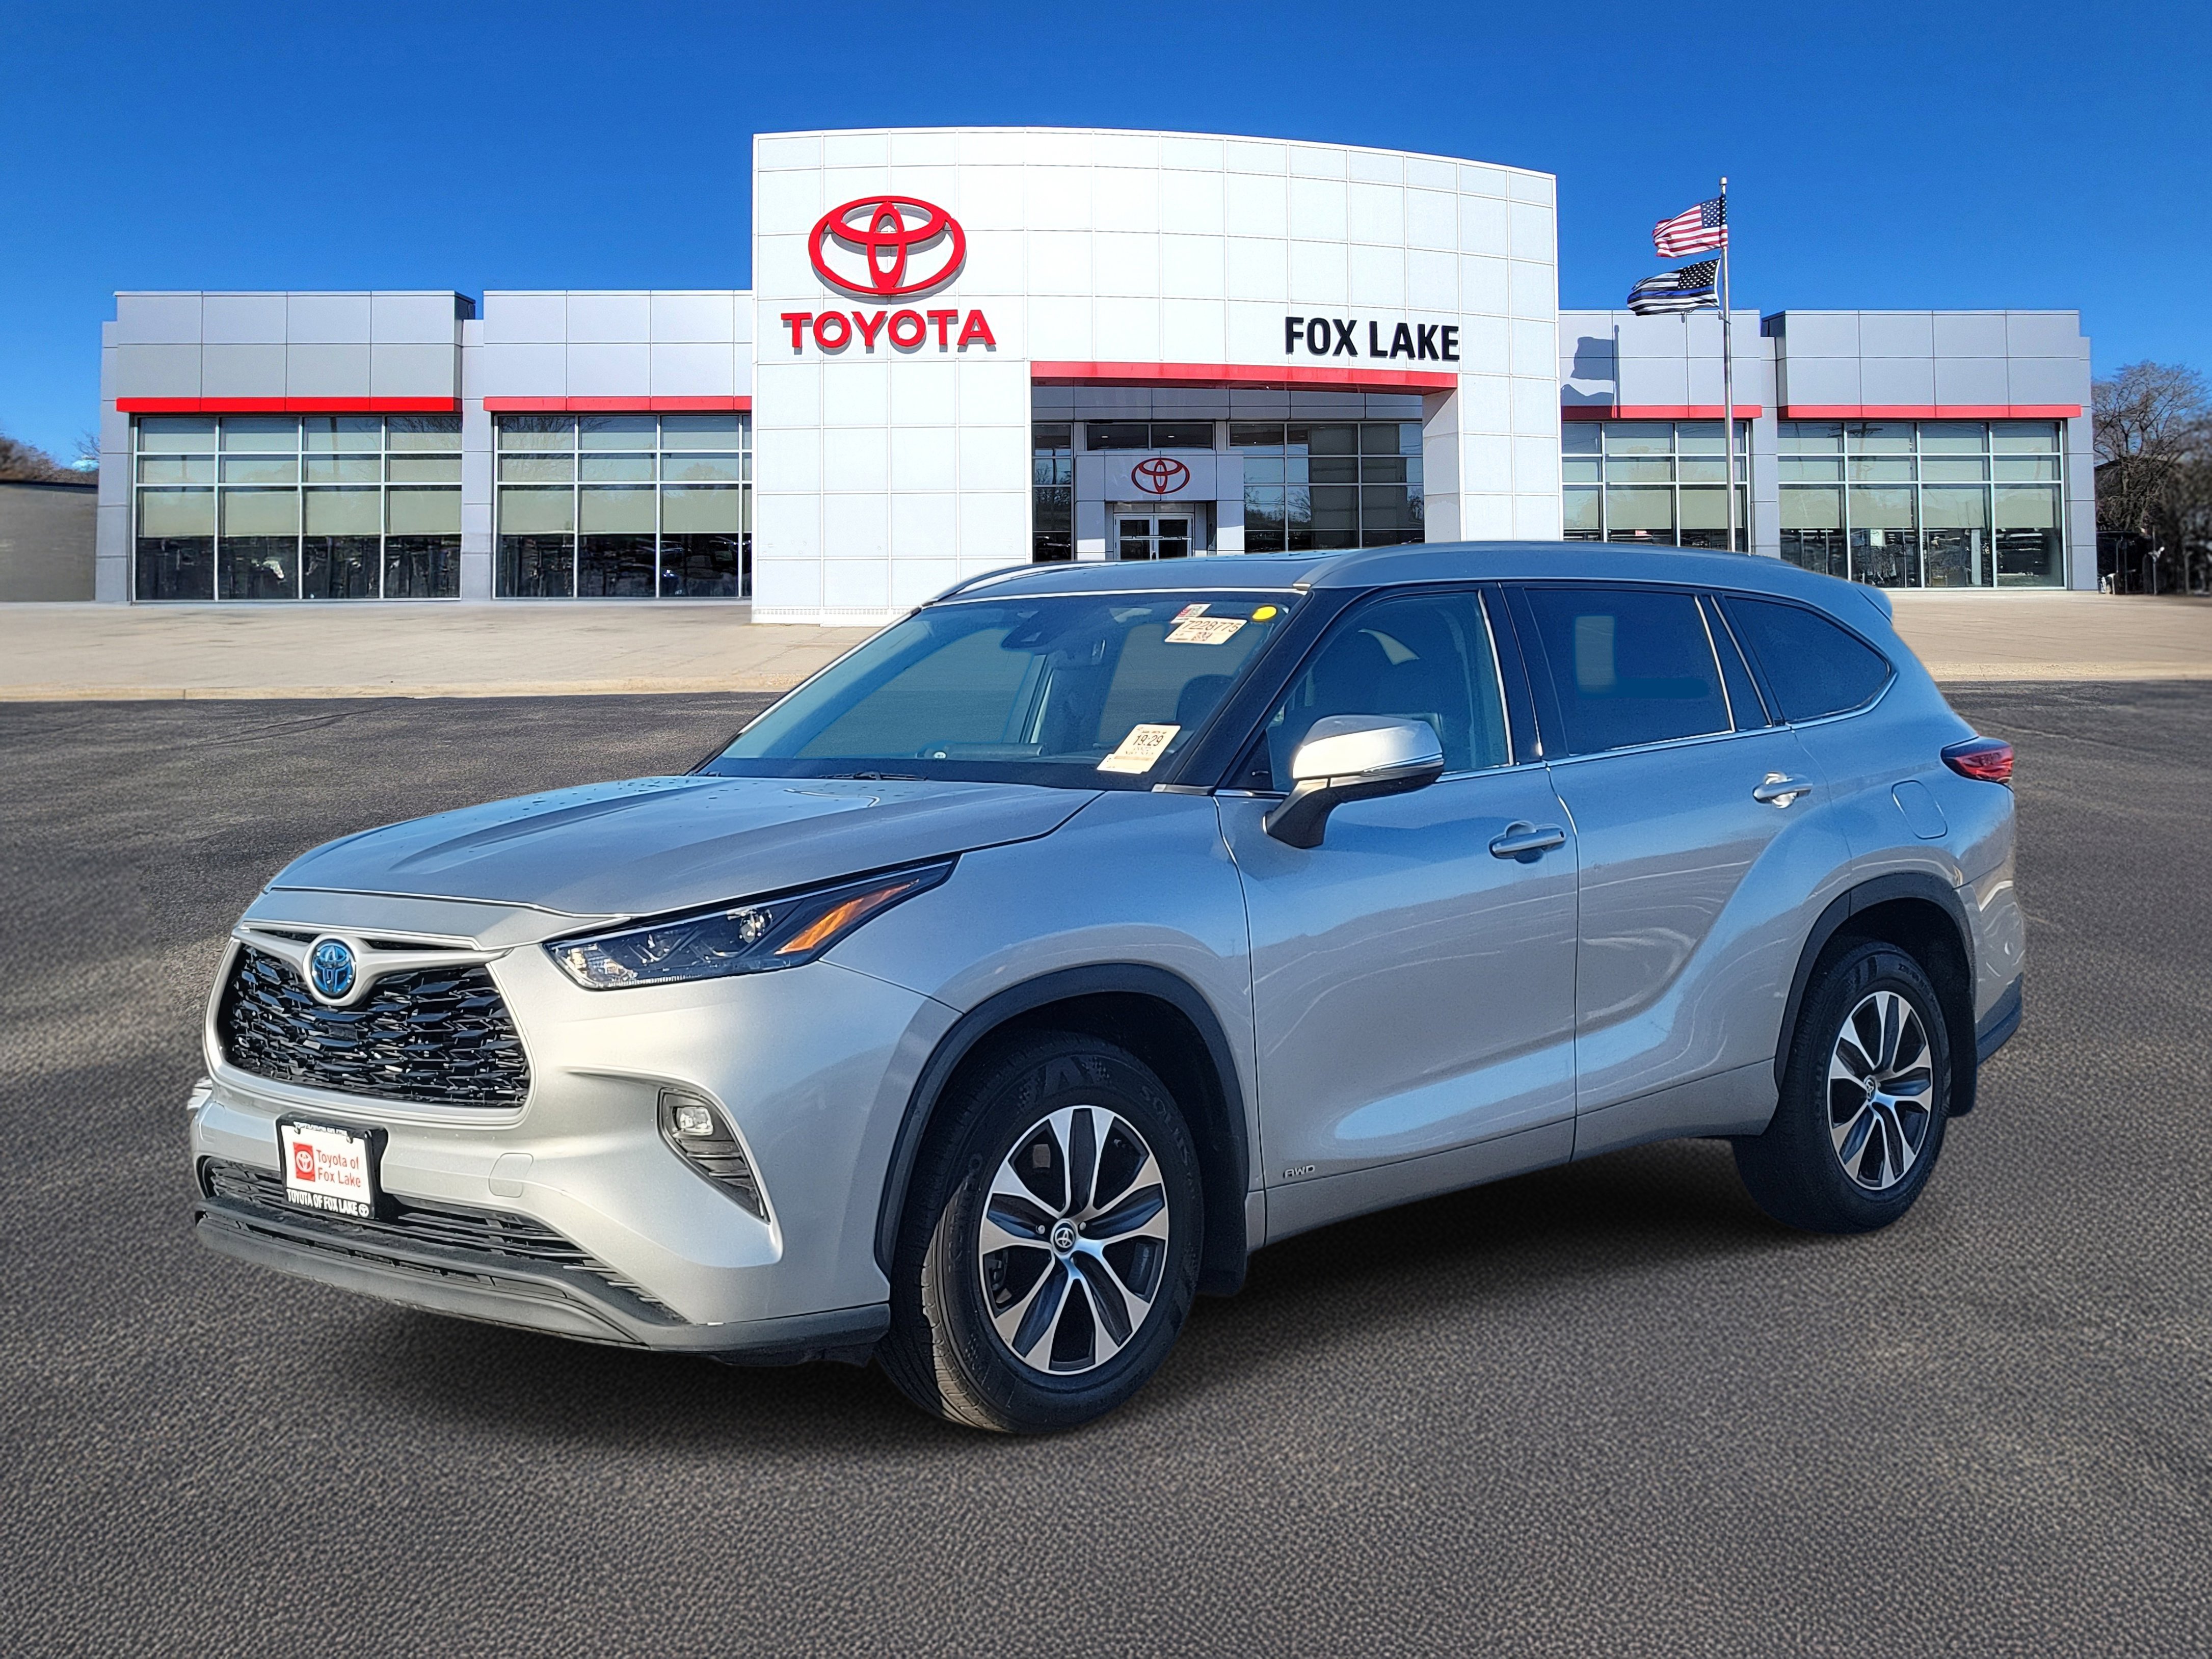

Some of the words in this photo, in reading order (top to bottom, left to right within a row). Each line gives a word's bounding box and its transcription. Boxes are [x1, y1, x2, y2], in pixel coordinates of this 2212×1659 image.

[781, 310, 996, 348] TOYOTA
[1285, 316, 1358, 356] FOX
[1369, 321, 1459, 360] LAKE
[1182, 620, 1242, 632] 7228775
[316, 1149, 347, 1168] Toyota
[350, 1156, 359, 1170] of
[318, 1167, 335, 1182] Fox
[338, 1170, 361, 1188] Lake
[1283, 1164, 1315, 1179] AWD
[286, 1188, 313, 1207] TOYOTA
[313, 1194, 323, 1209] OF
[324, 1196, 338, 1213] FOX
[338, 1199, 358, 1216] LAKE
